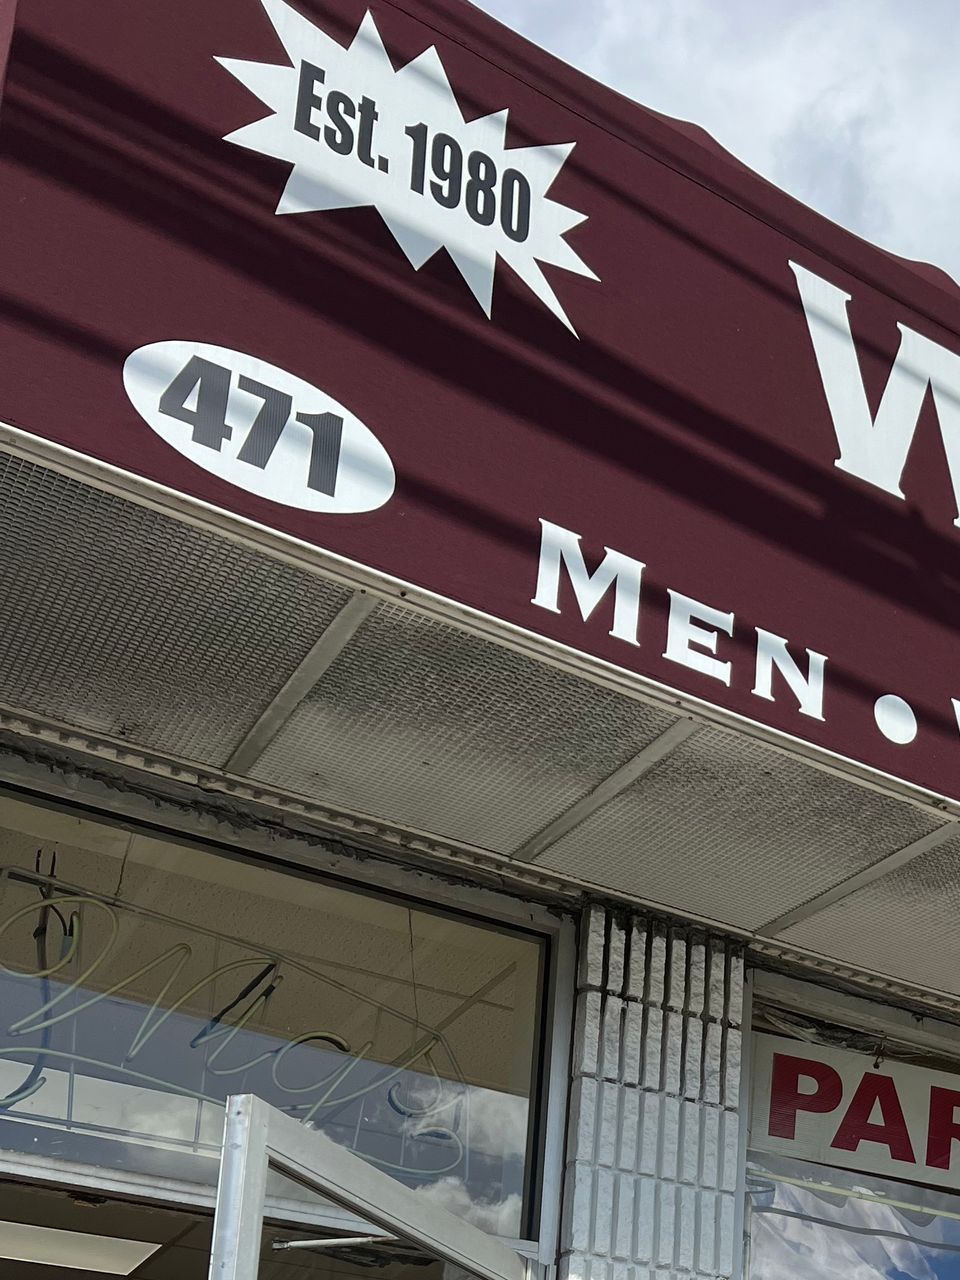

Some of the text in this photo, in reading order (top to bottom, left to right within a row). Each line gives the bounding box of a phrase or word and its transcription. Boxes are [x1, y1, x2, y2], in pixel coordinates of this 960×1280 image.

[293, 61, 531, 243] Est. 1980
[158, 355, 344, 498] 471
[531, 518, 829, 721] MEN
